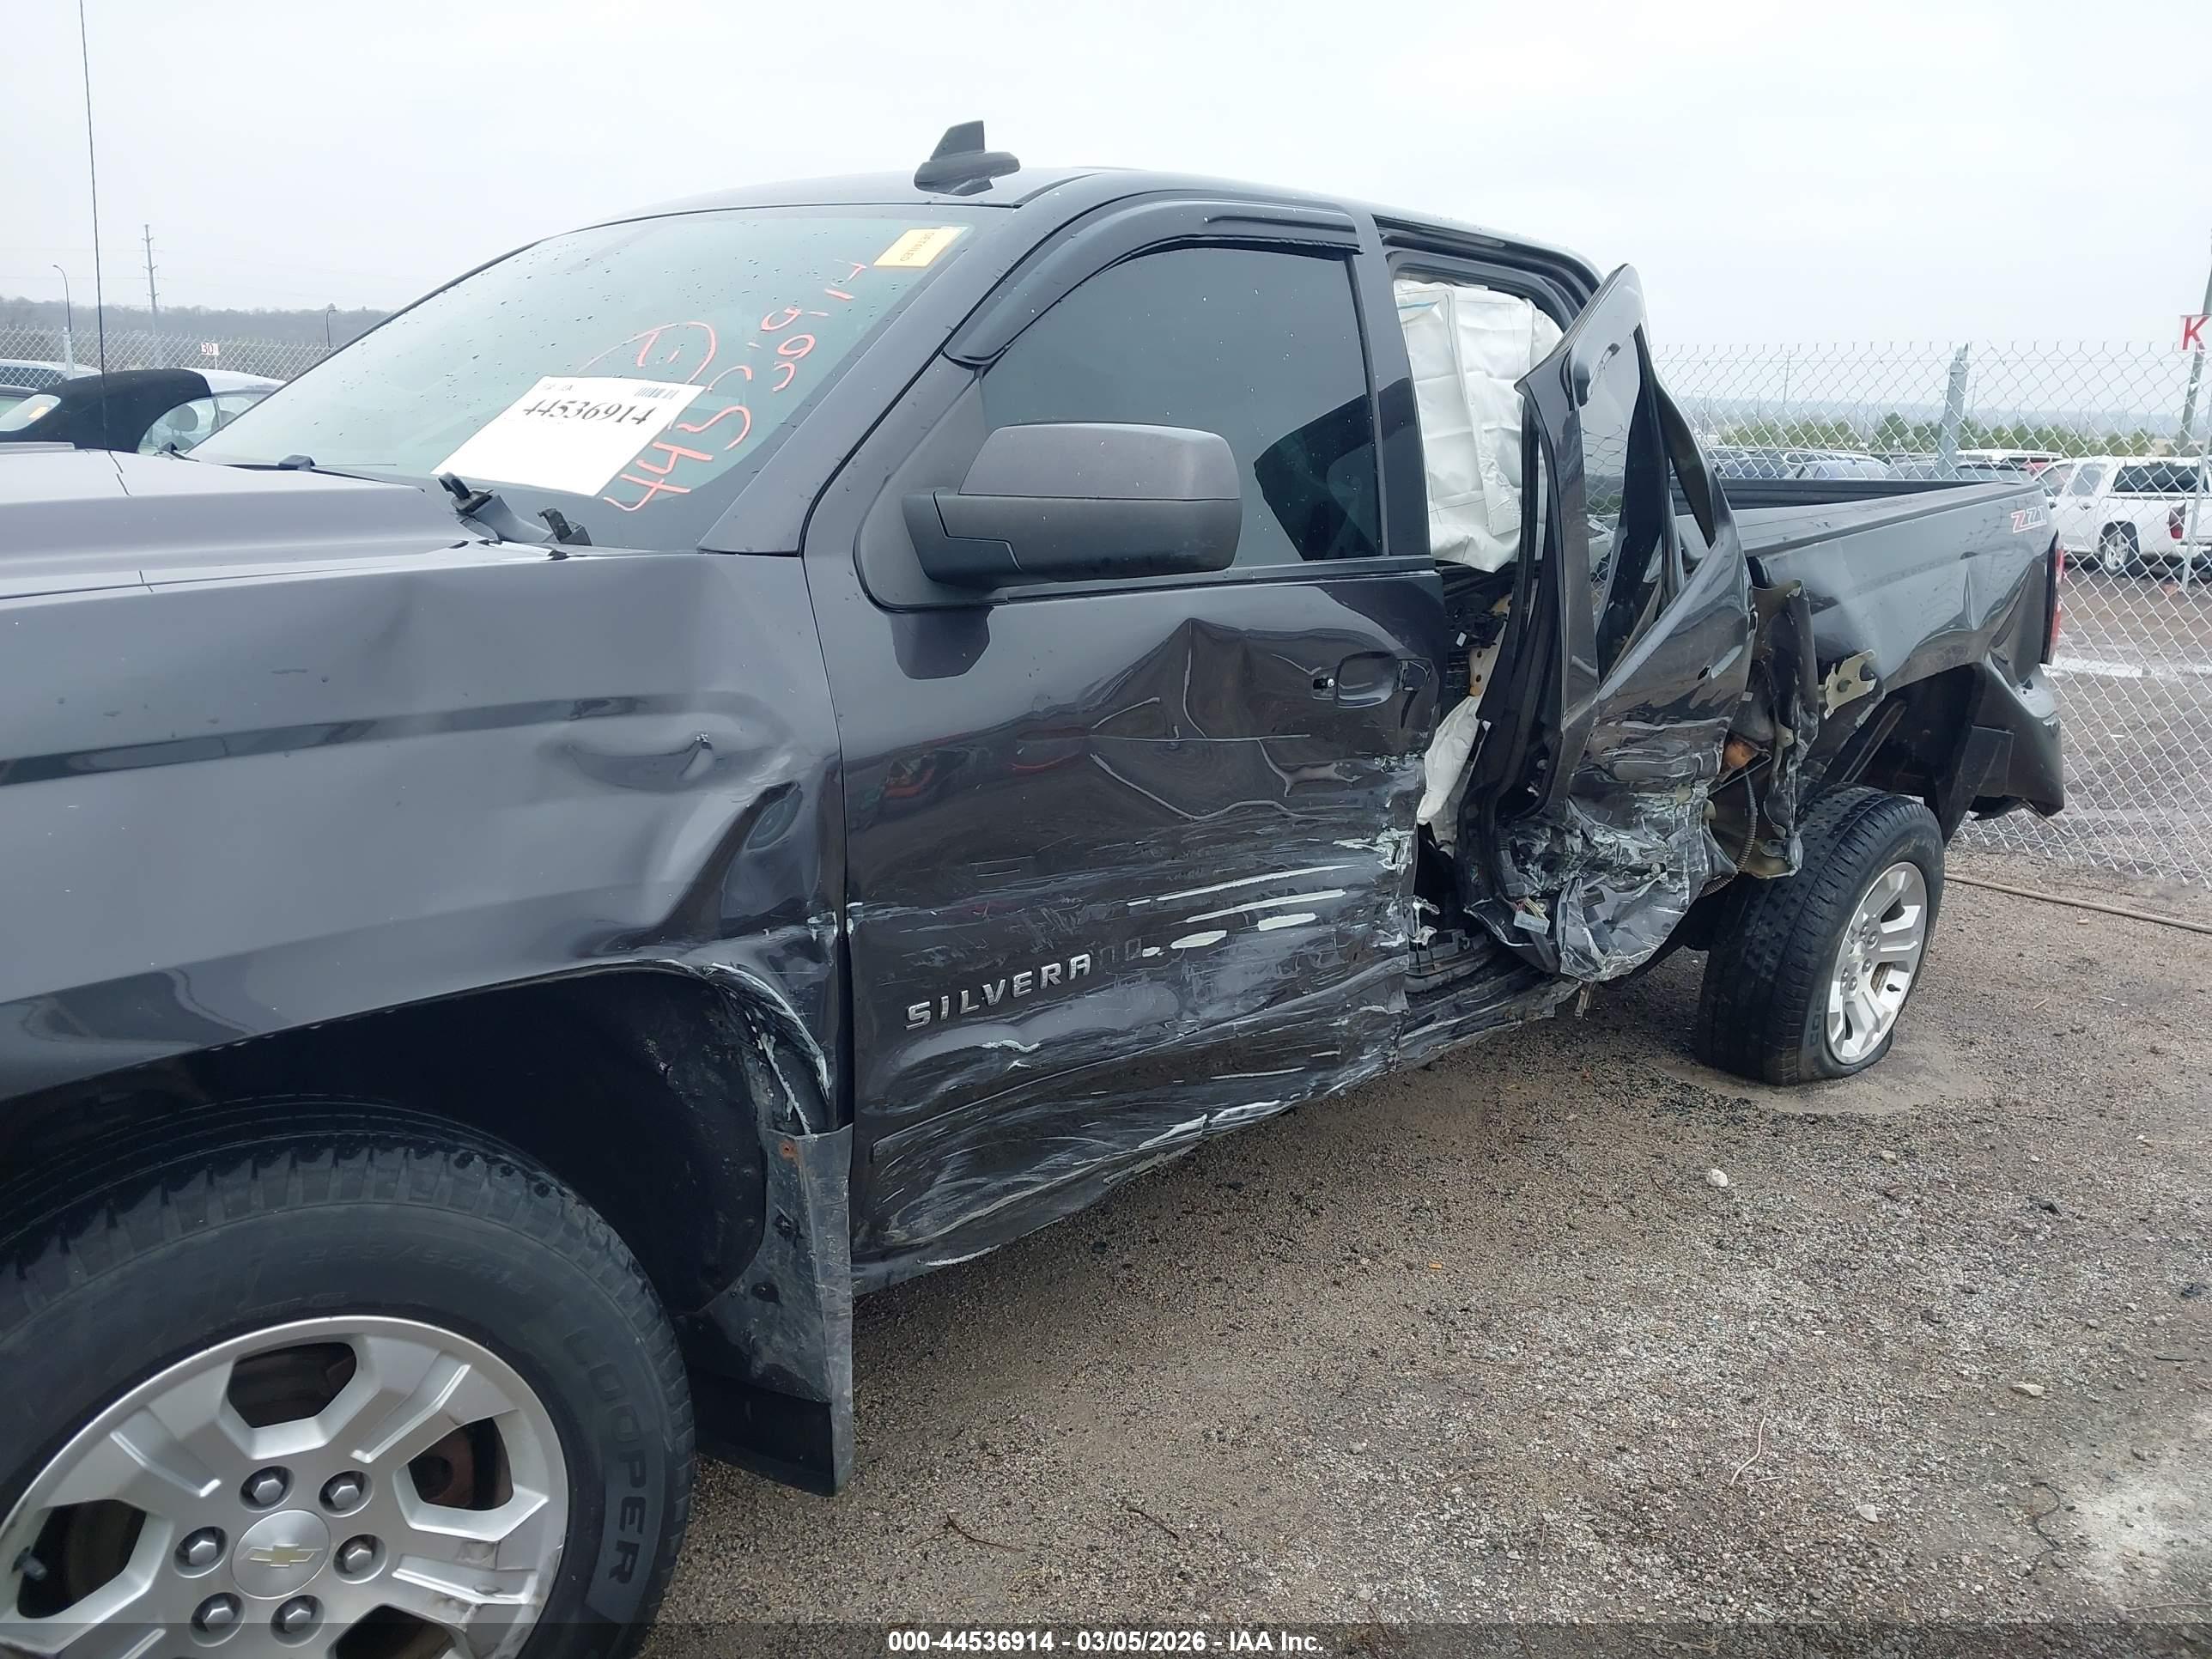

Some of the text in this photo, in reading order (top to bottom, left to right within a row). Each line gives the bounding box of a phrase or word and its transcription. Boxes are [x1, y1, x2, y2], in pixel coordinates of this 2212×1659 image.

[201, 343, 214, 355] 30
[2182, 315, 2210, 355] K
[522, 398, 659, 426] 44536914
[2010, 505, 2048, 533] Z71
[562, 1328, 647, 1586] COOPER
